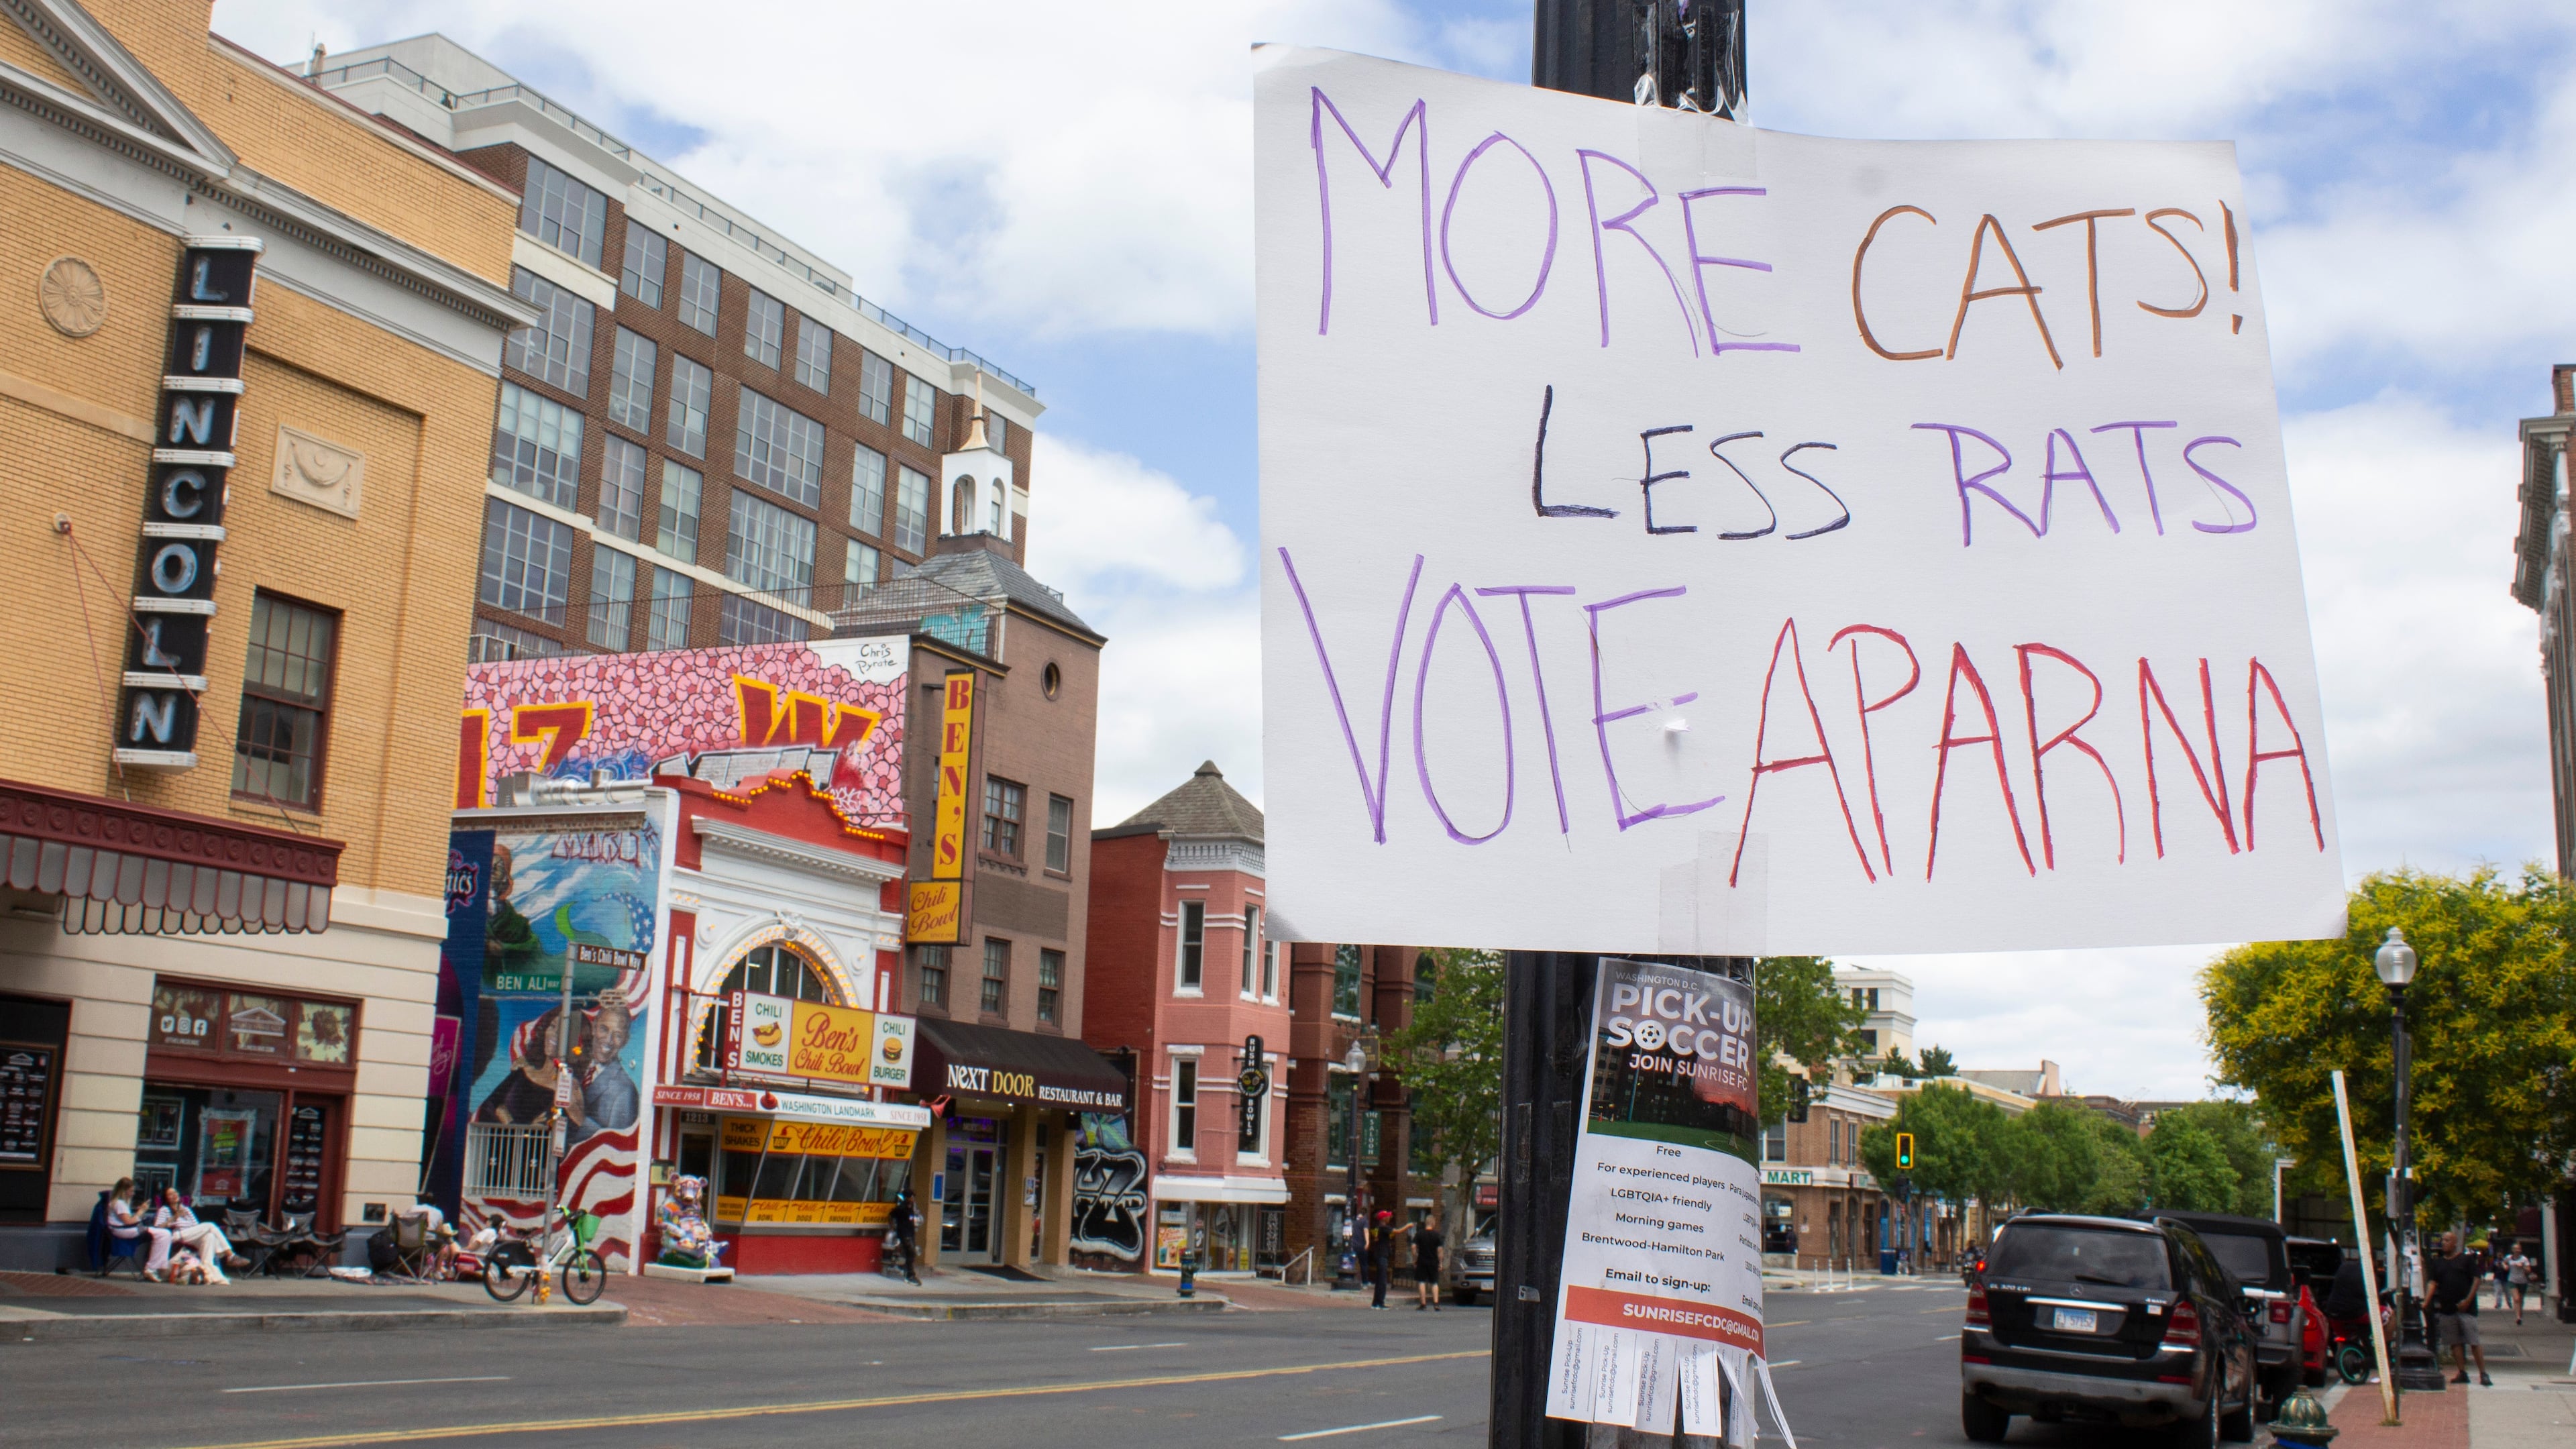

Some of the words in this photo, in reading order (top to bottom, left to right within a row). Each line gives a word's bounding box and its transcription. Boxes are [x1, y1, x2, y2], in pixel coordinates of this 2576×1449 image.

[1310, 85, 1800, 358] MORE
[1851, 199, 2244, 370] CATS!
[1531, 385, 1852, 541] LESS
[1910, 419, 2259, 548] RATS
[128, 254, 229, 745] LINCOLN
[861, 643, 892, 659] Chris
[855, 658, 898, 674] Pyrate
[1279, 546, 1726, 847] VOTE
[1729, 616, 2326, 888] APARNA
[940, 680, 970, 865] BEN'S
[911, 885, 947, 913] Chili
[909, 902, 958, 936] Bowl
[580, 947, 596, 963] Ben's
[598, 948, 613, 964] Chili
[613, 950, 628, 967] Bowl
[629, 952, 642, 971] Way
[496, 975, 522, 991] BEN
[528, 977, 547, 991] ALI
[547, 980, 560, 988] WAY
[1615, 971, 1681, 987] WASHINGTON
[1682, 981, 1699, 991] D.C.
[755, 1003, 782, 1019] CHILI
[1611, 982, 1751, 1037] PICK-UP
[727, 991, 743, 1068] BEN'S
[801, 1012, 859, 1053] Ben's
[882, 1022, 906, 1036] CHILI
[745, 1050, 784, 1067] SMOKES
[1248, 1038, 1256, 1067] RUSH
[1606, 1016, 1749, 1073] SOCCER
[794, 1048, 823, 1073] Chili
[825, 1052, 865, 1076] Bowl
[873, 1066, 906, 1081] BURGER
[1629, 1053, 1673, 1074] JOIN
[1677, 1060, 1735, 1086] SUNRISE
[1737, 1075, 1748, 1091] FC
[992, 1070, 1034, 1097] DOOR
[1039, 1085, 1095, 1104] RESTAURANT
[1095, 1092, 1104, 1106] &
[1105, 1093, 1122, 1107] BAR
[655, 1091, 682, 1101] SINCE
[683, 1091, 701, 1102] 1958
[781, 1099, 833, 1115] WASHINGTON
[834, 1105, 876, 1119] LANDMARK
[890, 1110, 912, 1120] SINCE
[914, 1112, 928, 1123] 1958
[685, 1112, 709, 1124] 1213
[1246, 1098, 1254, 1136] BOWLS
[724, 1134, 761, 1148] SHAKES
[731, 1122, 757, 1134] THICK
[799, 1126, 845, 1150] Chili
[845, 1129, 896, 1154] Bowl
[1656, 1144, 1681, 1158] Free
[1597, 1162, 1617, 1173] For
[1619, 1166, 1690, 1183] experienced
[1693, 1174, 1726, 1191] players
[1729, 1183, 1742, 1196] Para
[1767, 1171, 1811, 1185] MART
[1611, 1187, 1669, 1203] LGBTQIA+
[1672, 1195, 1713, 1213] friendly
[1615, 1212, 1665, 1230] Morning
[1668, 1221, 1705, 1234] games
[1582, 1232, 1703, 1258] Brentwood-Hamilton
[1705, 1249, 1725, 1262] Park
[1605, 1268, 1642, 1283] Email
[1645, 1273, 1658, 1285] to
[1662, 1275, 1711, 1293] sign-up:
[1564, 1340, 1573, 1367] Pick-Up
[1601, 1345, 1609, 1372] Pick-Up
[1641, 1350, 1650, 1379] Pick-Up
[1562, 1368, 1570, 1395] Sunrise
[1570, 1327, 1582, 1410] sunrisefcdc@gmail.com
[1608, 1332, 1619, 1413] sunrisefcdc@gmail.com
[1646, 1338, 1660, 1421] sunrisefcdc@gmail.com
[1599, 1373, 1607, 1399] Sunrise
[1638, 1379, 1647, 1407] Sunrise
[1693, 1344, 1701, 1425] sunrisefcdc@gmail.com
